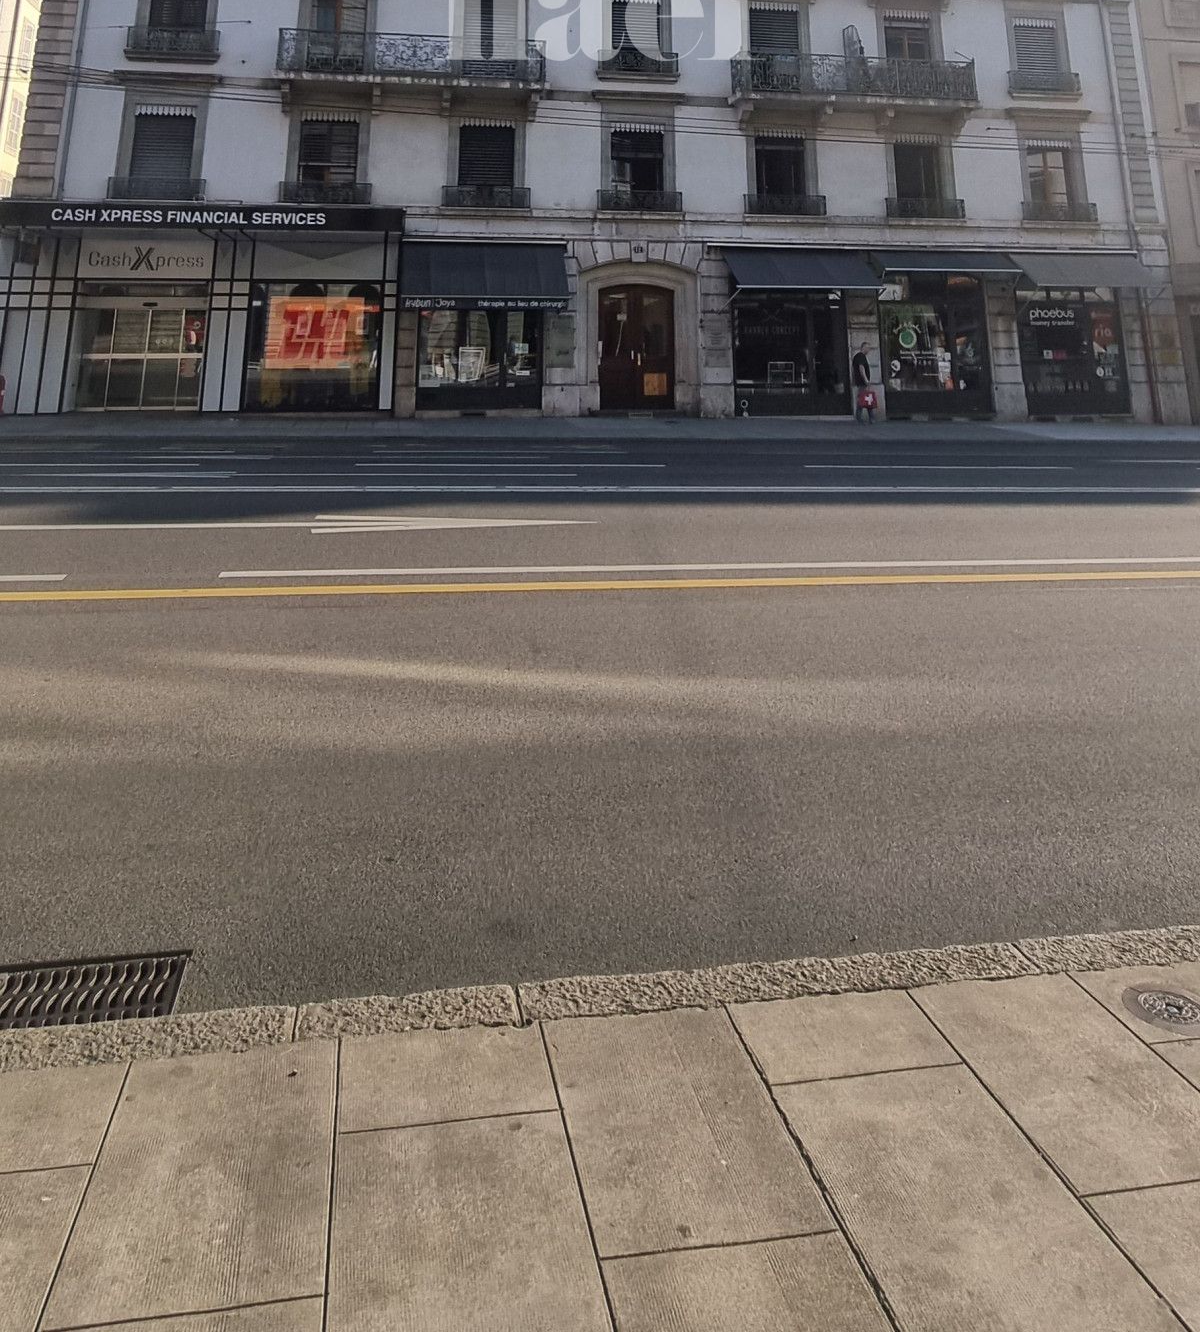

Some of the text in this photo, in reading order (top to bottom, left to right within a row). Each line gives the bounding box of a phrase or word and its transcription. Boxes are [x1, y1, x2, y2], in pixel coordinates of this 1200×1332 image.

[51, 208, 326, 226] CASH XPRESS FINANCIAL SERVICES
[1029, 307, 1075, 321] phoebus
